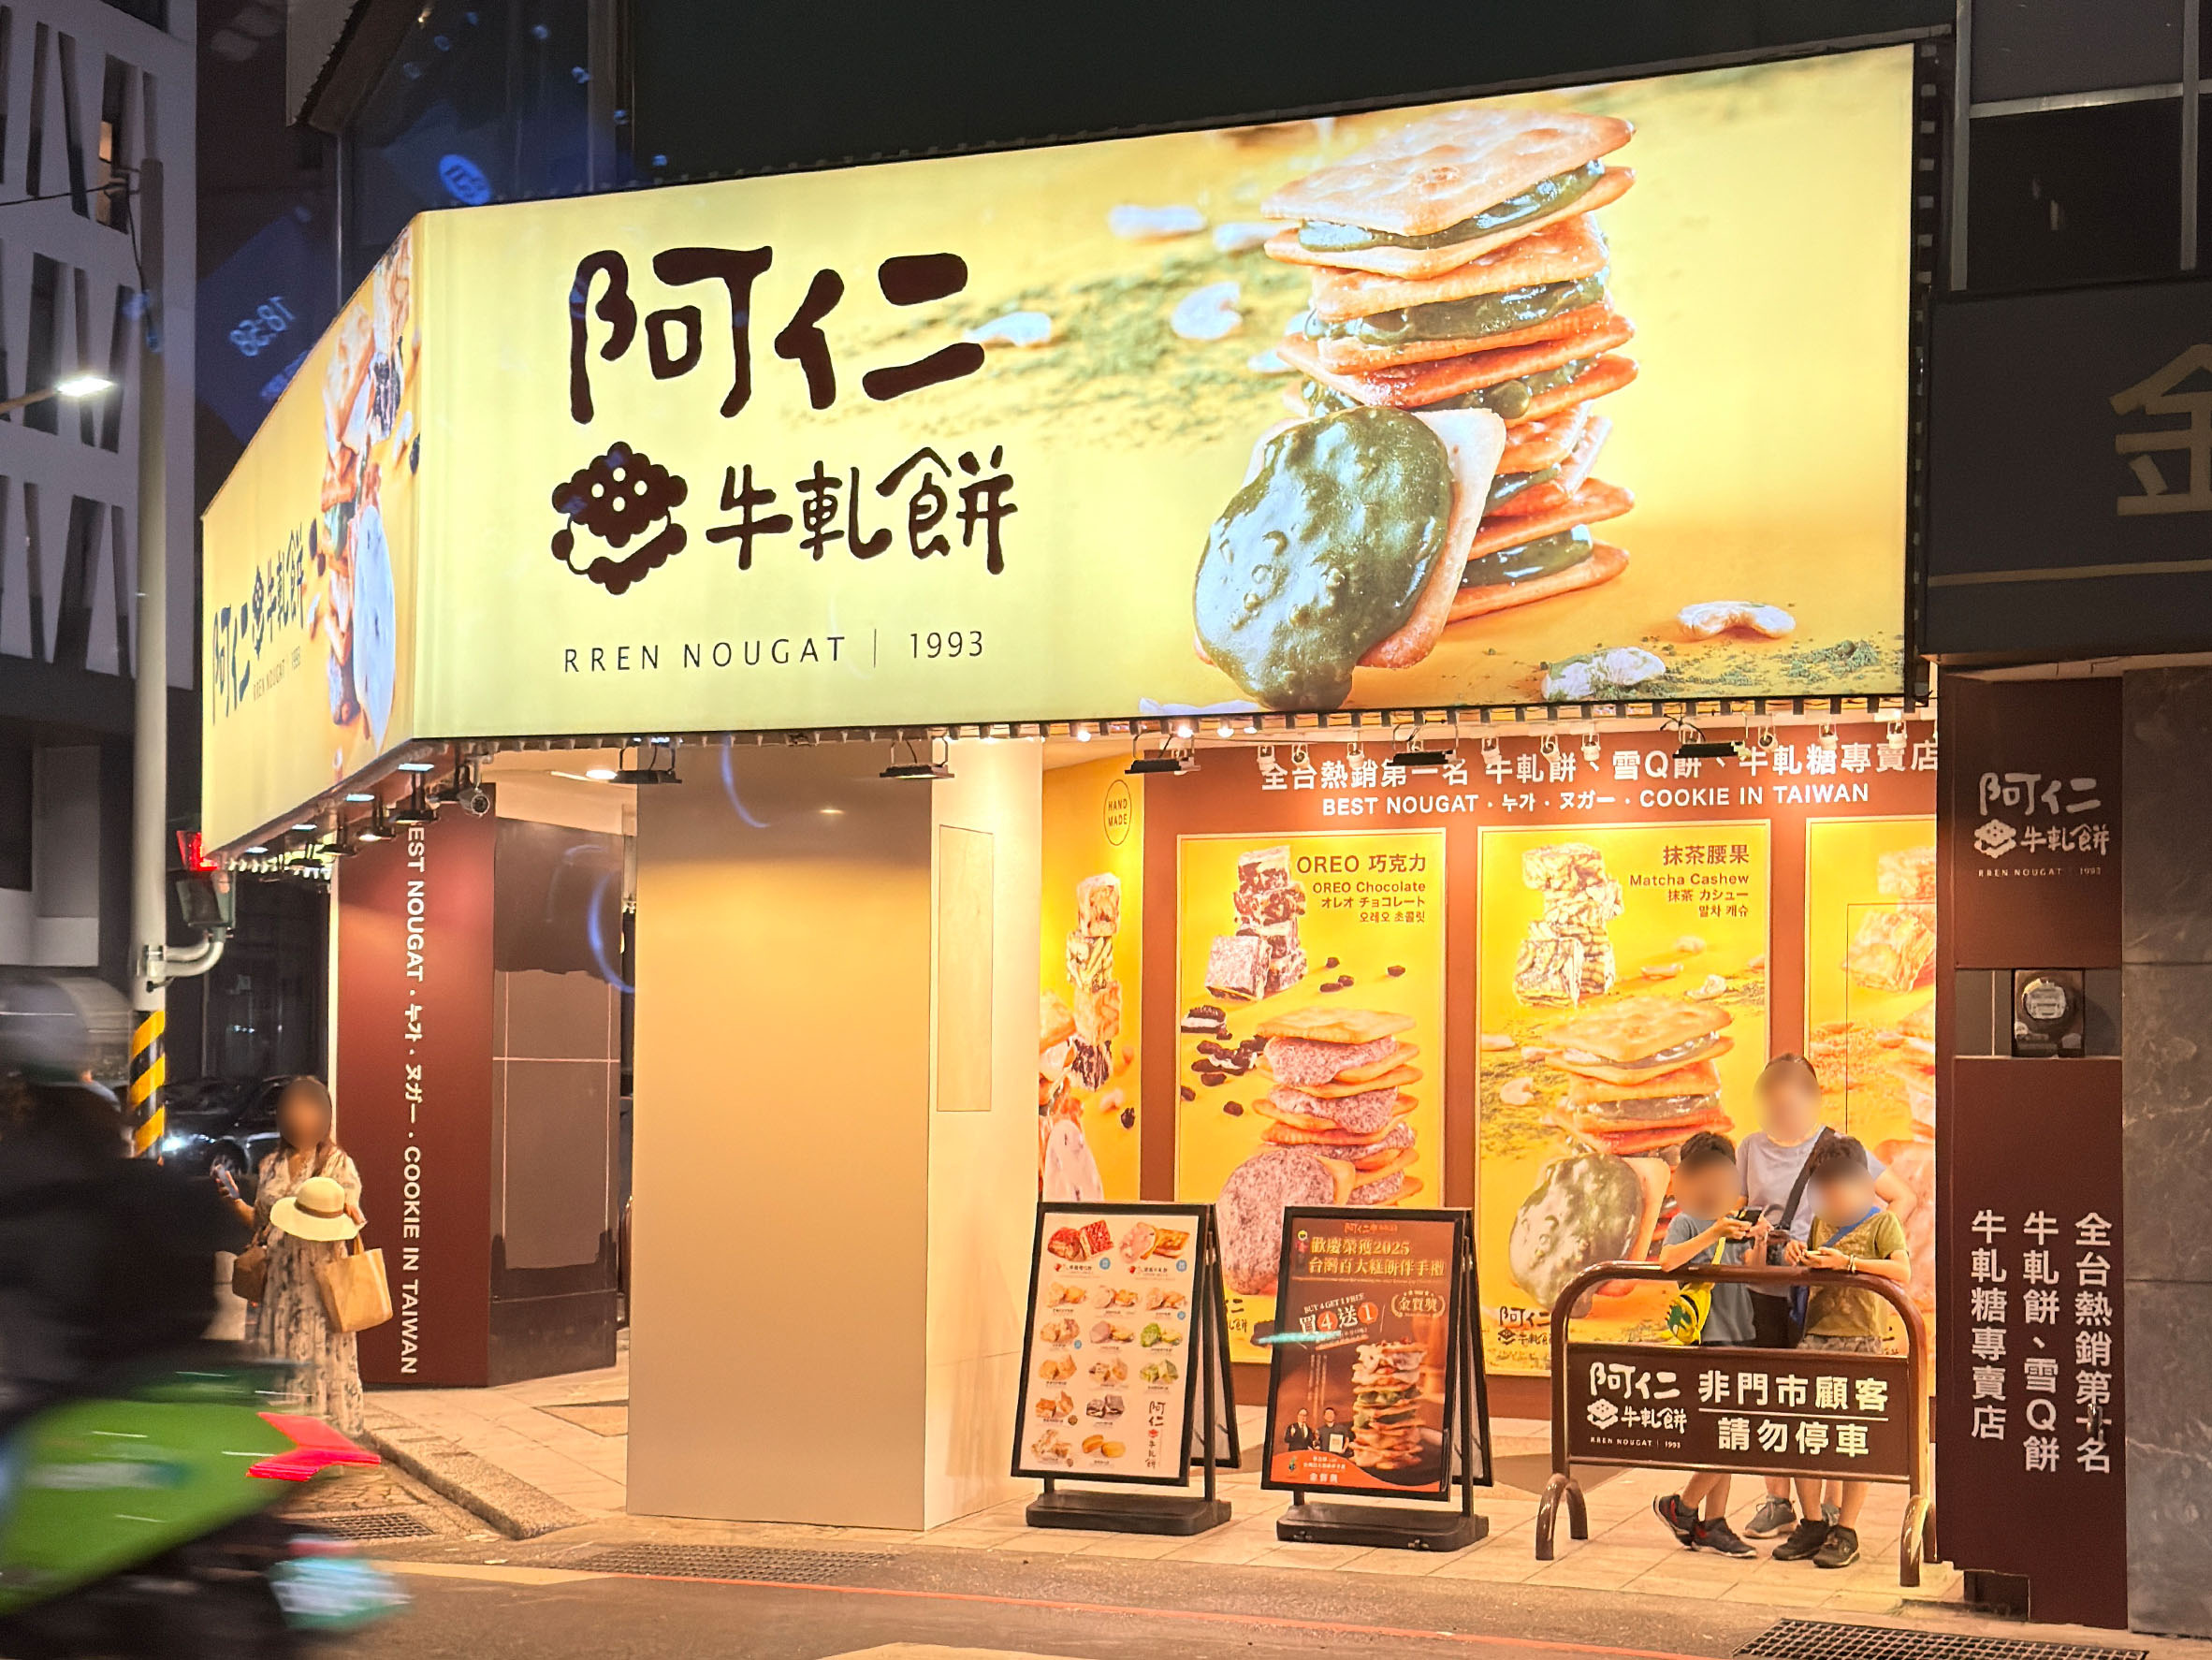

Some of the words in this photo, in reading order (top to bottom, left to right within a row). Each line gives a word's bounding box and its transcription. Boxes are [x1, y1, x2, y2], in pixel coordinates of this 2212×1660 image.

[570, 246, 985, 424] 阿仁
[706, 445, 1018, 575] 牛軋餅
[212, 602, 250, 726] 阿仁
[268, 521, 303, 643] 牛軋餅
[564, 645, 659, 673] RREN
[684, 636, 845, 668] NOUGAT
[910, 631, 983, 659] 1993
[1261, 758, 1468, 791] 全台熱銷第一名
[1108, 798, 1128, 811] HAND
[1322, 797, 1379, 816] BEST
[1386, 794, 1479, 814] NOUGAT
[1502, 793, 1535, 812] 누가
[1559, 789, 1616, 810] ヌガー
[1639, 788, 1730, 808] COOKIE
[1739, 786, 1763, 806] IN
[1772, 782, 1869, 804] TAIWAN
[1979, 772, 2102, 817] 阿仁
[1108, 813, 1128, 826] MADE
[408, 823, 425, 872] EST
[1662, 844, 1750, 866] 抹茶腰果
[2020, 823, 2110, 856] 牛軋餅
[1297, 854, 1360, 874] OREO
[1368, 852, 1426, 873] 巧克力
[1629, 874, 1685, 886] Matcha
[1690, 872, 1750, 885] Cashew
[2014, 866, 2062, 877] NOUGAT
[1313, 881, 1351, 894] OREO
[1356, 881, 1426, 894] Chocolate
[1321, 896, 1354, 909] オレオ
[1359, 896, 1425, 908] チョコレート
[1668, 889, 1693, 902] 抹茶
[1699, 888, 1749, 901] カシュー
[406, 881, 425, 982] NOUGAT
[1360, 911, 1390, 923] 오레오
[405, 1003, 423, 1041] 누가
[404, 1064, 423, 1123] ヌガー
[403, 1146, 421, 1239] COOKIE
[402, 1247, 419, 1271] IN
[1304, 1303, 1319, 1314] BUY
[1325, 1299, 1339, 1309] GET
[1346, 1292, 1365, 1303] FREE
[1500, 1306, 1550, 1327] 阿仁
[400, 1279, 418, 1374] TAIWAN
[1971, 1209, 2007, 1441] 牛軋糖專賣店
[2023, 1211, 2059, 1472] 牛軋餅、雪Q餅
[2075, 1212, 2113, 1474] 全台熱銷第一名
[1590, 1361, 1681, 1399] 阿仁
[1698, 1369, 1889, 1412] 非門市顧客
[1621, 1405, 1688, 1434] 牛軋餅
[1616, 1438, 1652, 1447] NOUGAT
[1718, 1417, 1870, 1458] 請勿停車
